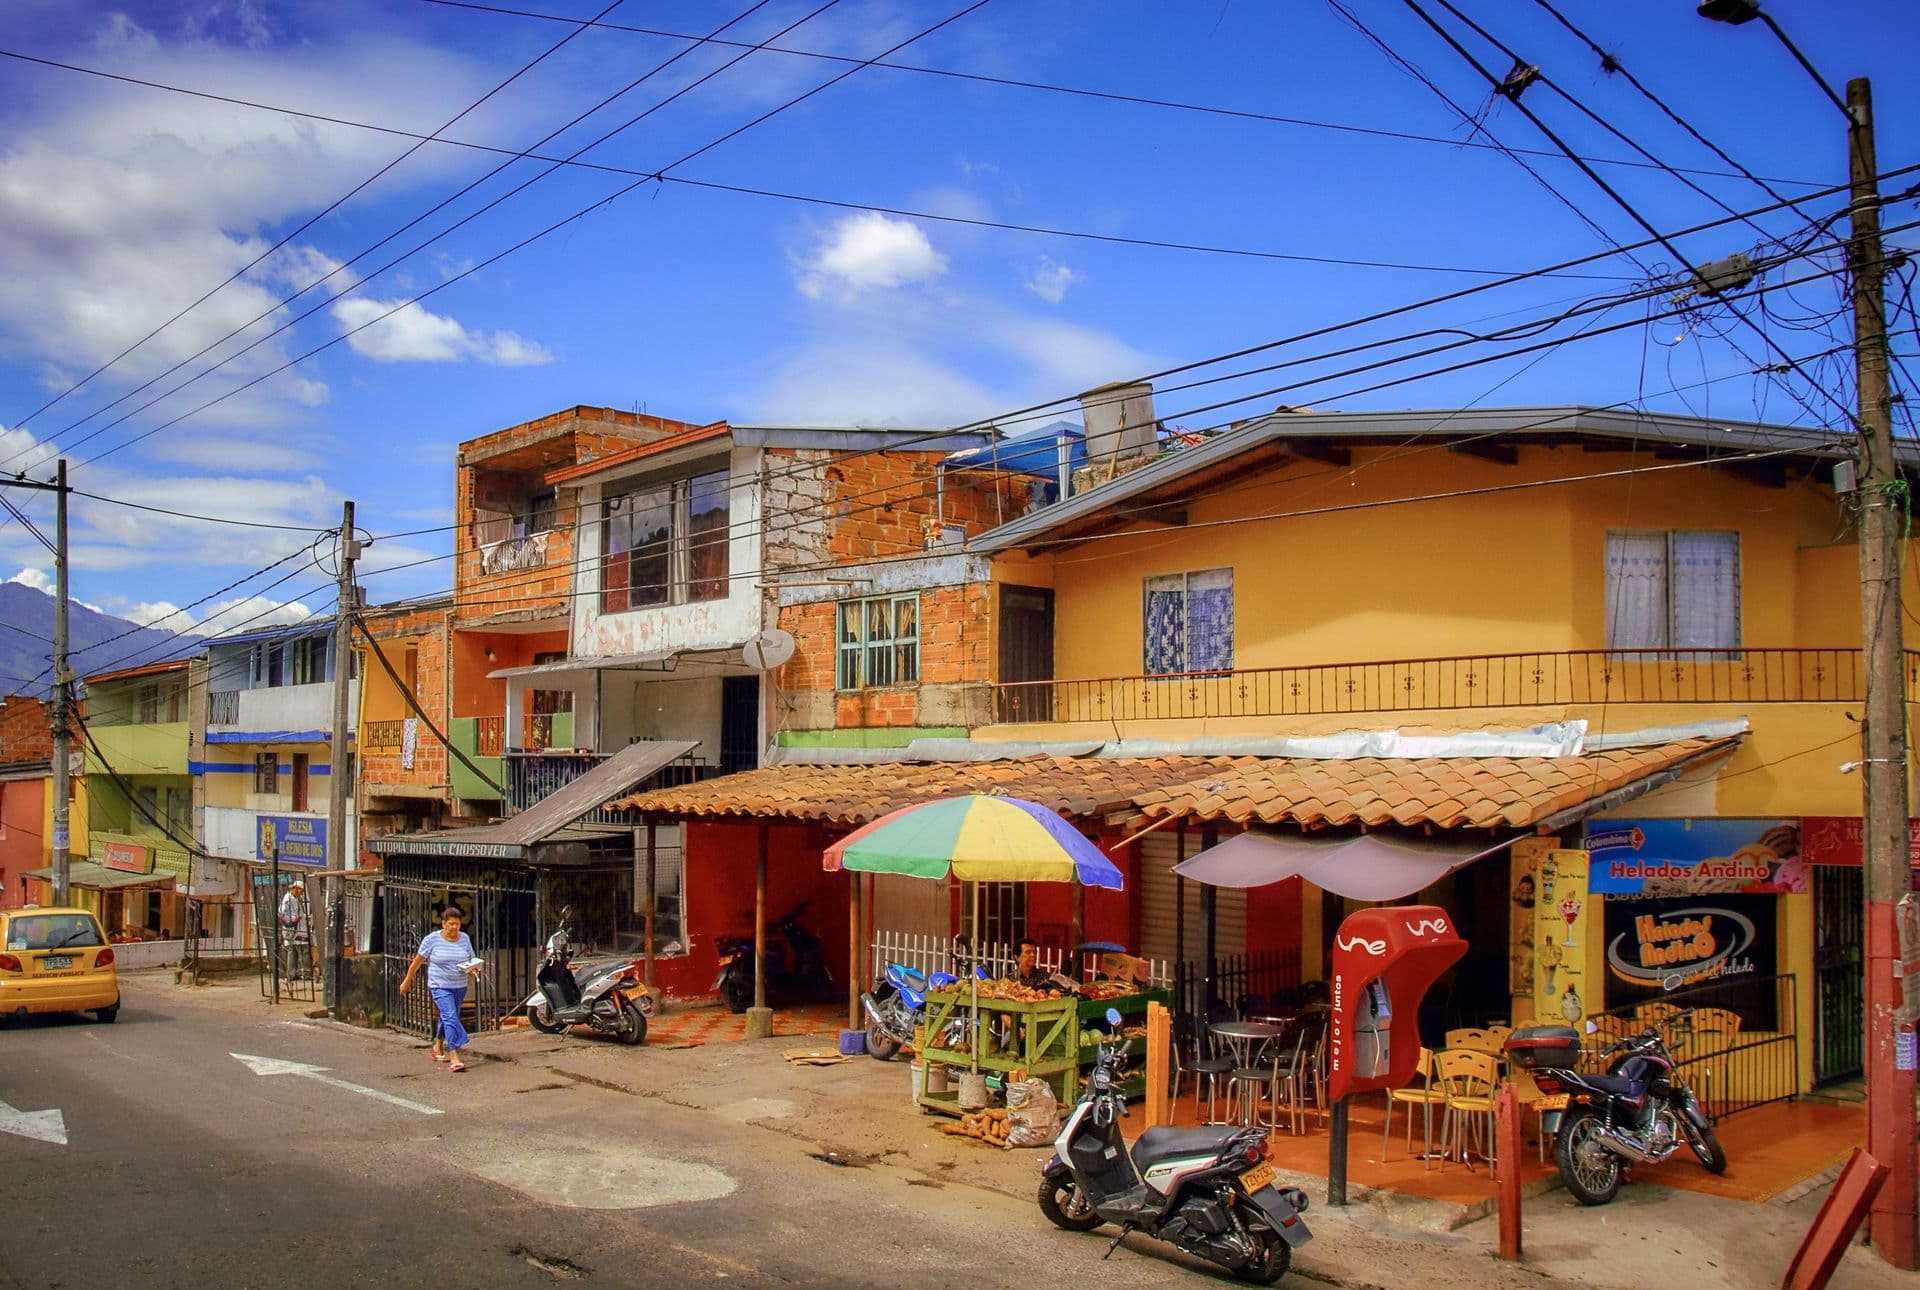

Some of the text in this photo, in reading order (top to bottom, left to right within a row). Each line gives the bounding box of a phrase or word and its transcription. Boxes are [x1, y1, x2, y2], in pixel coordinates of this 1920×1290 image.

[376, 841, 507, 857] UTOPIA RUMBA CROSSOVER
[1586, 833, 1629, 849] Colombina
[1610, 862, 1769, 879] Helados Andino
[1406, 918, 1447, 936] une
[1337, 934, 1386, 955] une
[1334, 975, 1343, 1012] juntos
